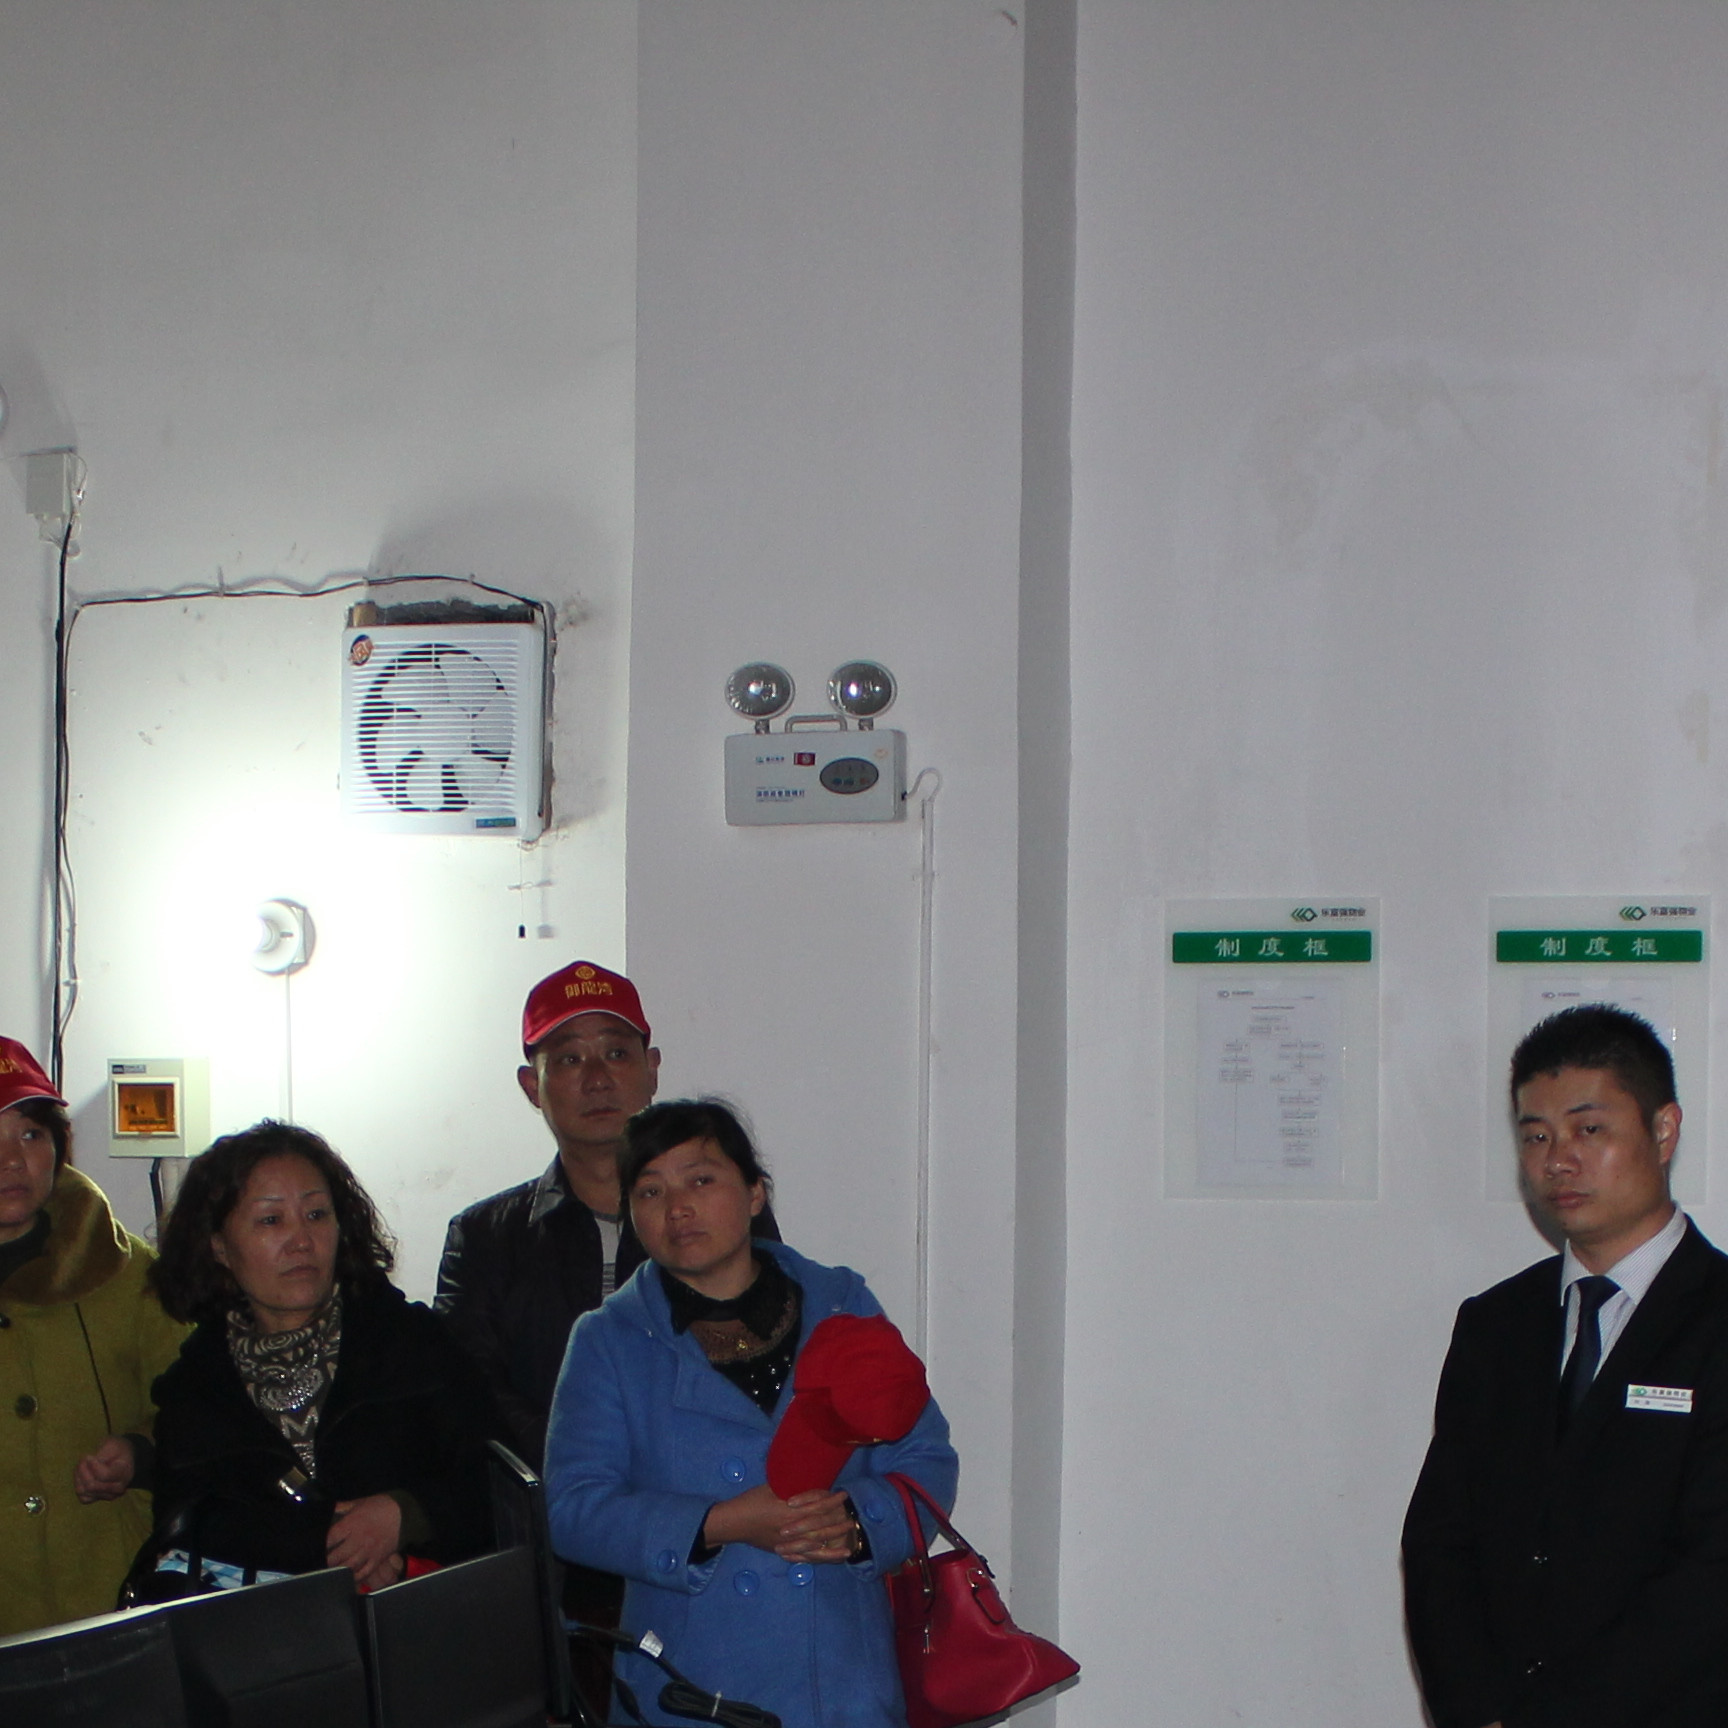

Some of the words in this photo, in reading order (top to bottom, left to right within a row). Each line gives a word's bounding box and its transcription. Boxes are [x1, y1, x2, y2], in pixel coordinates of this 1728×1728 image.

[1215, 937, 1329, 957] 制度框
[1540, 936, 1658, 957] 制度框
